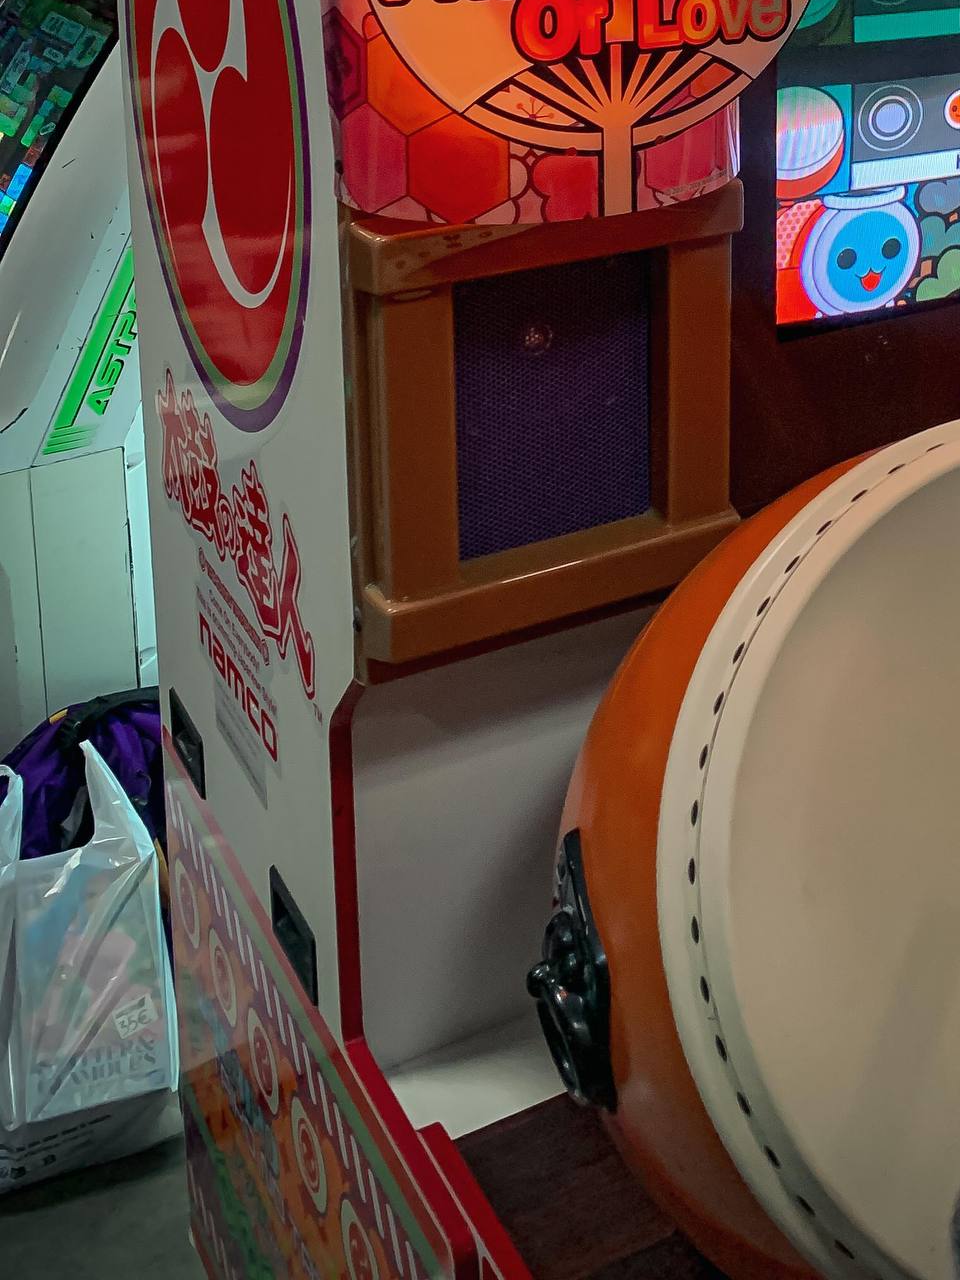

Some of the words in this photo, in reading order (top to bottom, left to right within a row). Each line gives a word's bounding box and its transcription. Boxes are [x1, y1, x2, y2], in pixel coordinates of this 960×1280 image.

[155, 368, 316, 700] 太鼓の達人
[199, 611, 279, 762] namco
